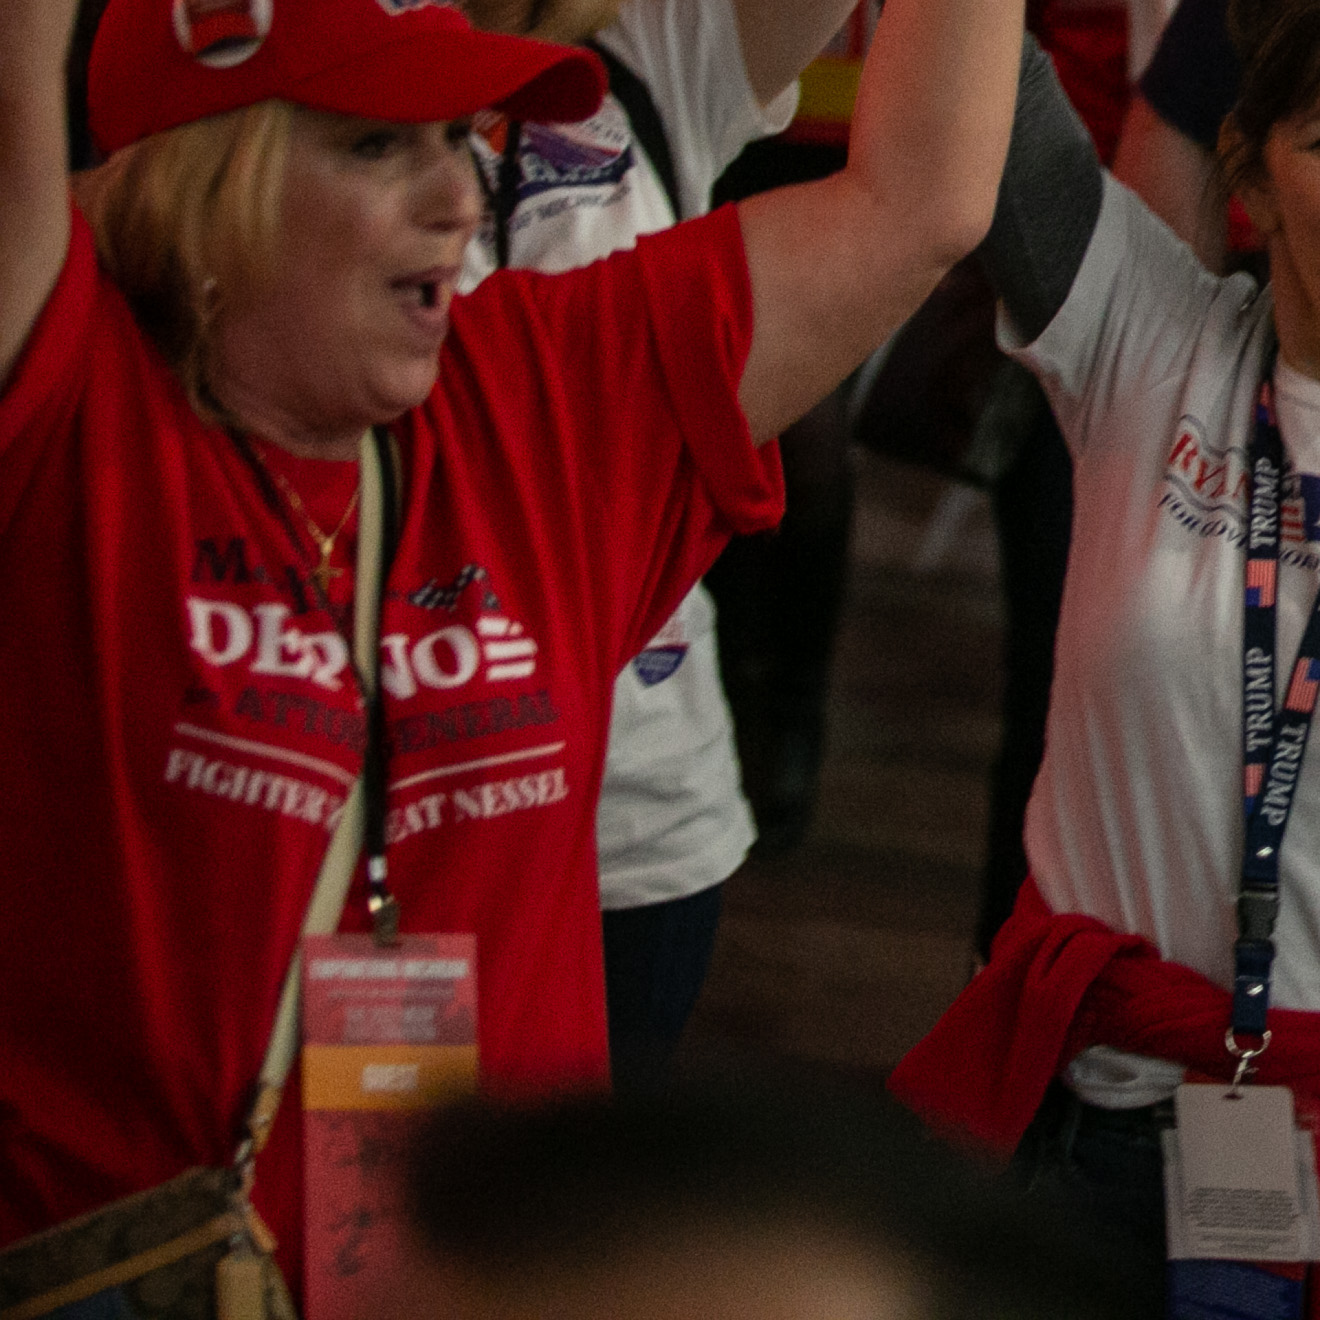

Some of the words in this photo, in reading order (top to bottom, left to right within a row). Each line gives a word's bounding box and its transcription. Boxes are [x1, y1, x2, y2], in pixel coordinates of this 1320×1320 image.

[1249, 456, 1280, 550] TRUMP
[1245, 645, 1274, 753] TRUMP
[1260, 720, 1308, 829] TRUMP
